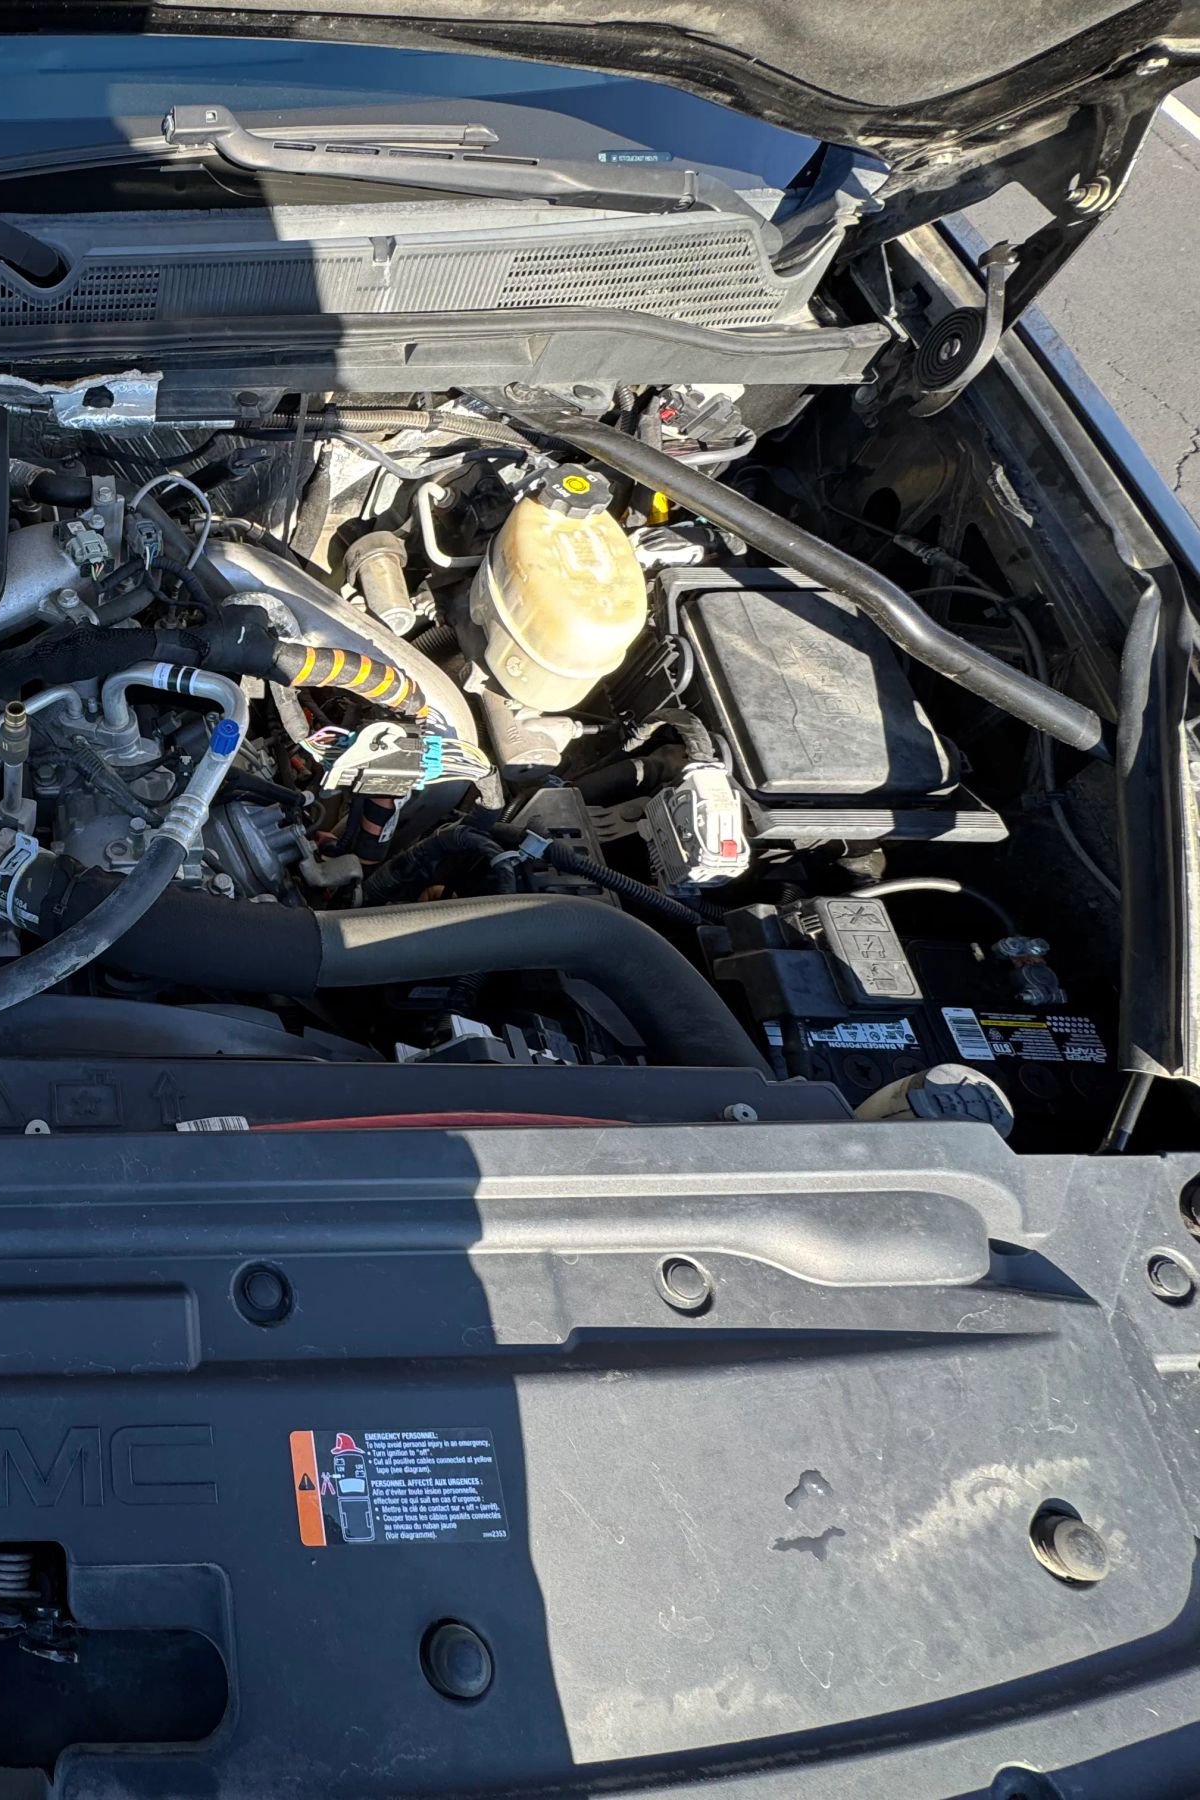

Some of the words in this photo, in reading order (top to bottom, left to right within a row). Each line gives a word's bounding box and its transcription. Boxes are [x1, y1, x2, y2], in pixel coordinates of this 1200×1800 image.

[1062, 1047, 1107, 1056] START
[1065, 1054, 1106, 1063] SUPER
[402, 1432, 438, 1440] PERSONNEL:
[374, 1441, 386, 1450] help
[403, 1441, 426, 1449] personal
[387, 1449, 408, 1458] ignition
[393, 1457, 415, 1466] positive
[436, 1456, 465, 1464] connected
[473, 1456, 492, 1464] yellow
[408, 1478, 433, 1486] AFFECTÉ
[448, 1478, 479, 1486] URGENCES
[372, 1488, 384, 1496] Afin
[425, 1487, 441, 1495] lésion
[410, 1497, 418, 1505] qui
[383, 1514, 403, 1522] Couper
[393, 1522, 412, 1530] niveau
[441, 1522, 457, 1530] jaune
